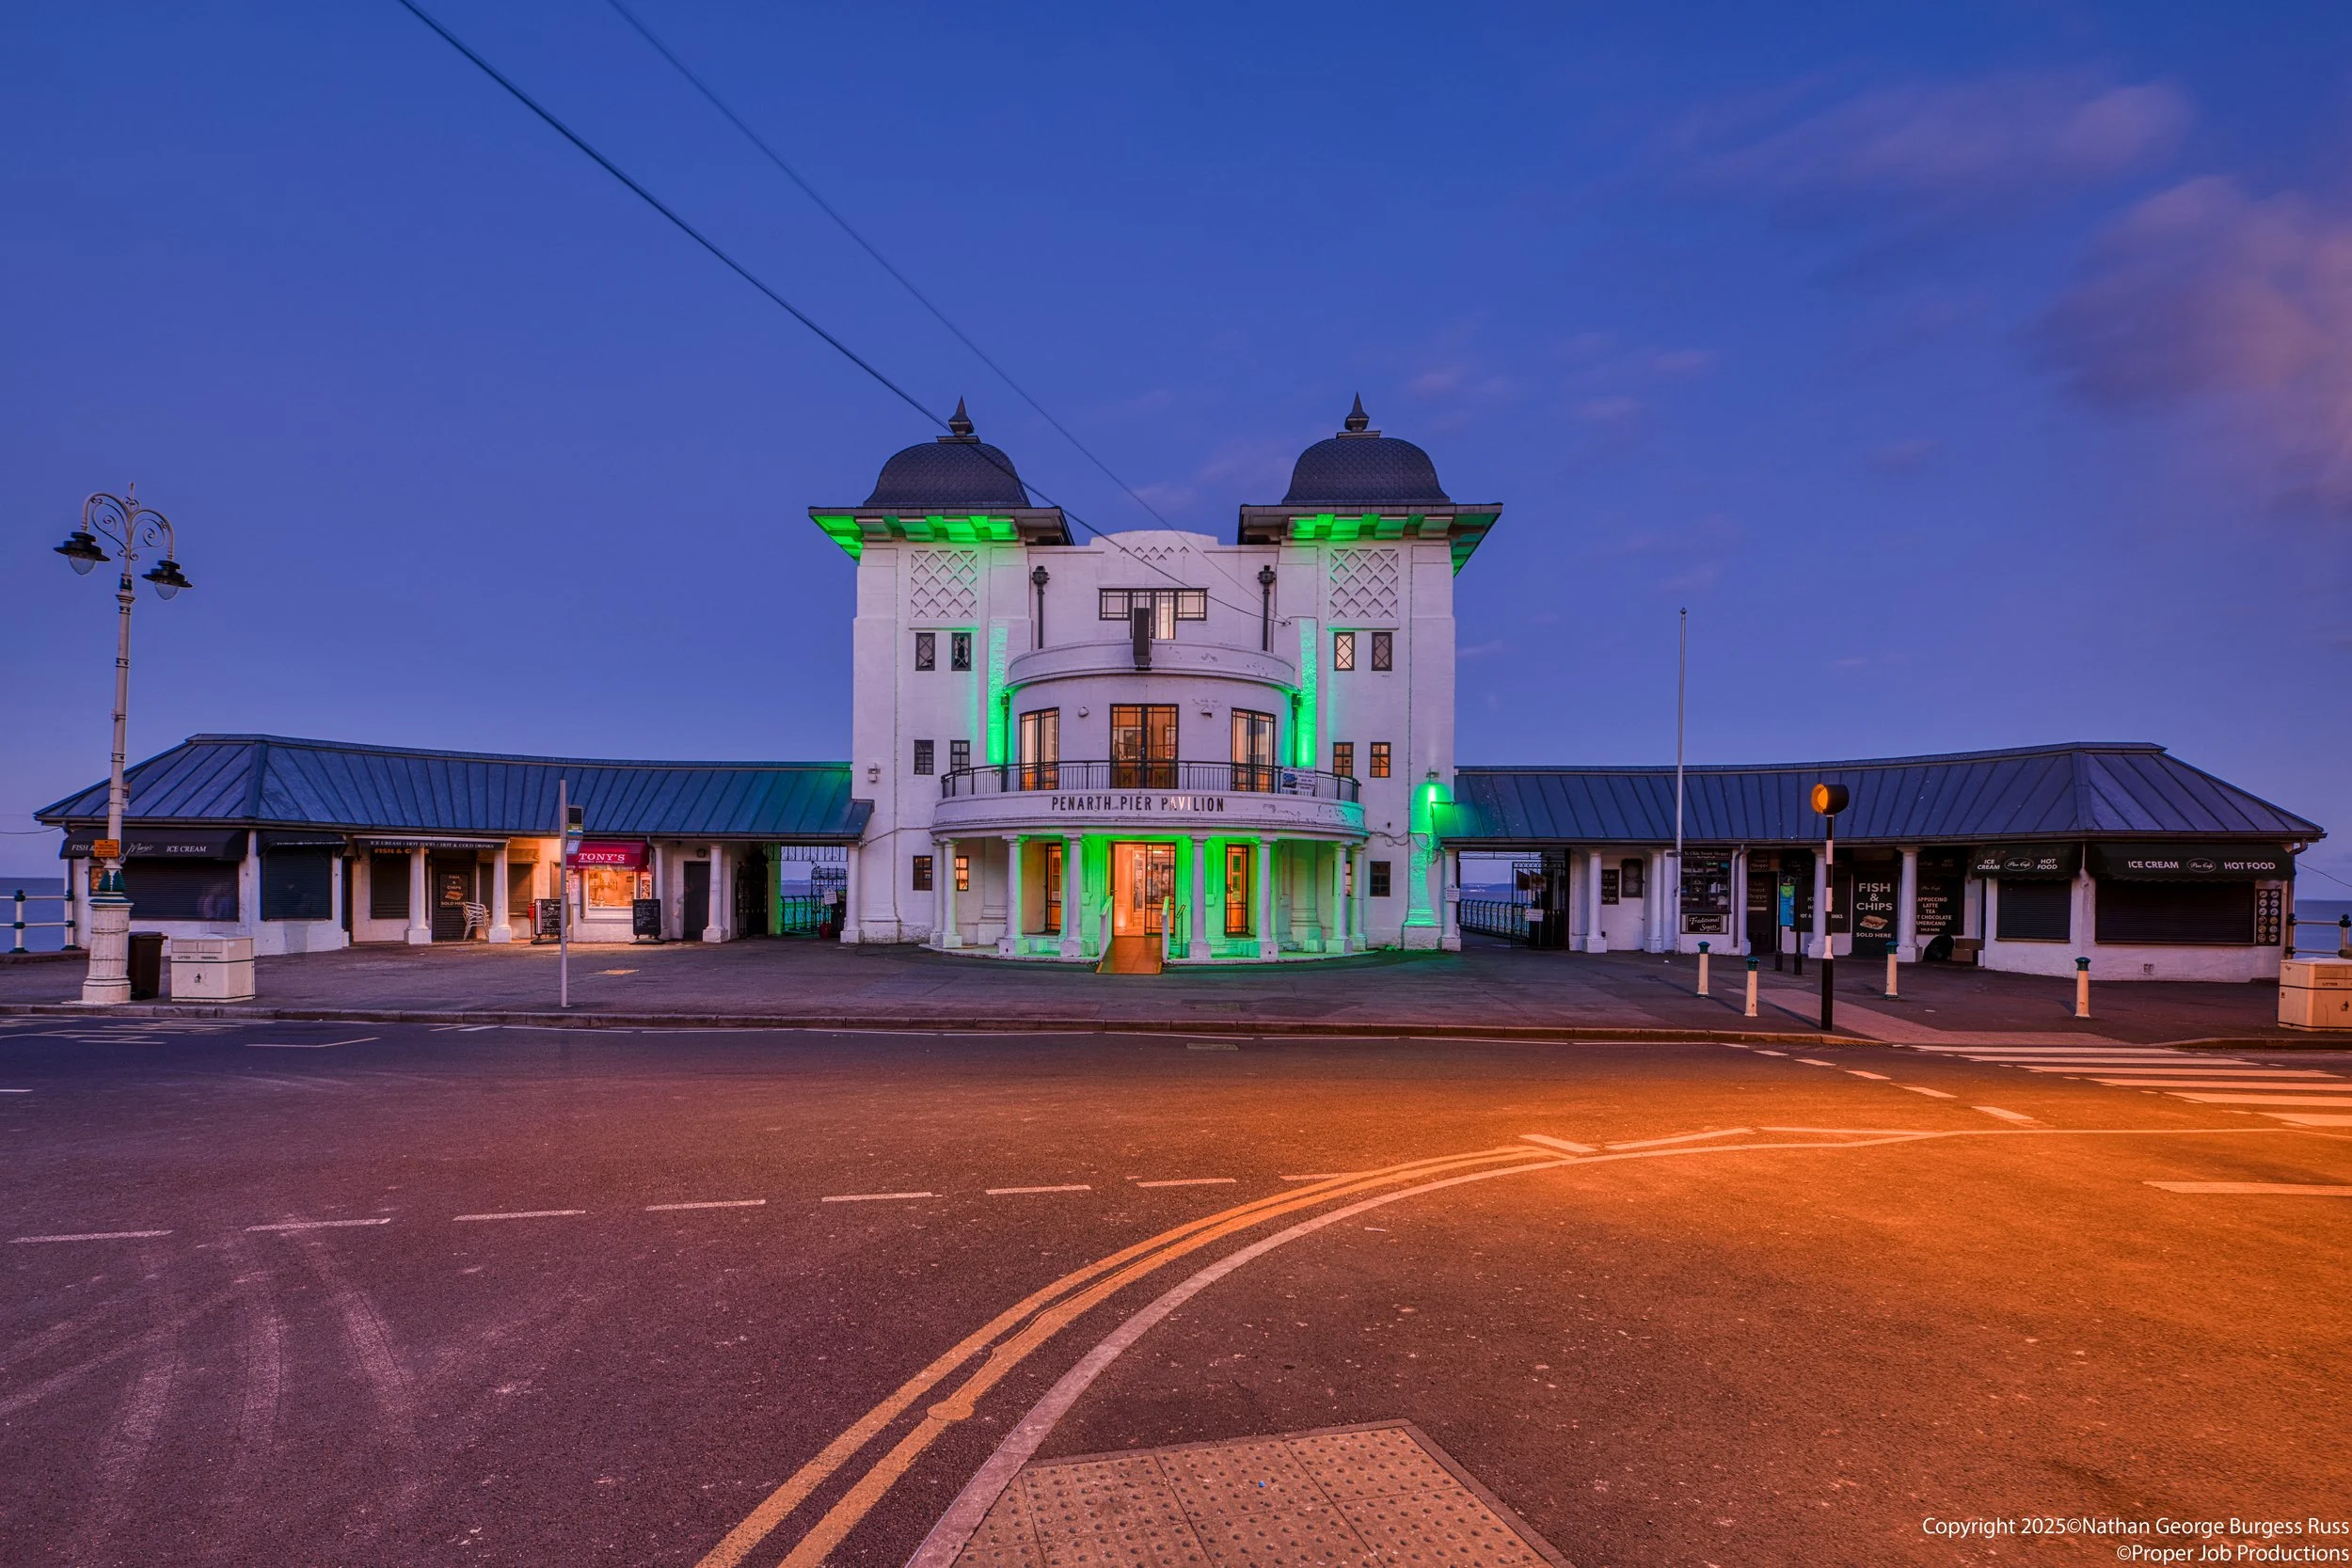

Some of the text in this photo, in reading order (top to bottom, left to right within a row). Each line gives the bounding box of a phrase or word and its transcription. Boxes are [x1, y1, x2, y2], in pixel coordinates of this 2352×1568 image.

[1052, 796, 1224, 812] PENARTH PIER PAVILION
[580, 853, 626, 862] TONY'S
[2144, 861, 2180, 869] CREAM
[2224, 861, 2276, 870] HOT FOOD
[1858, 882, 1891, 893] FISH
[1869, 893, 1880, 902] &
[1855, 902, 1893, 911] CHIPS
[1689, 916, 1720, 926] Traditional
